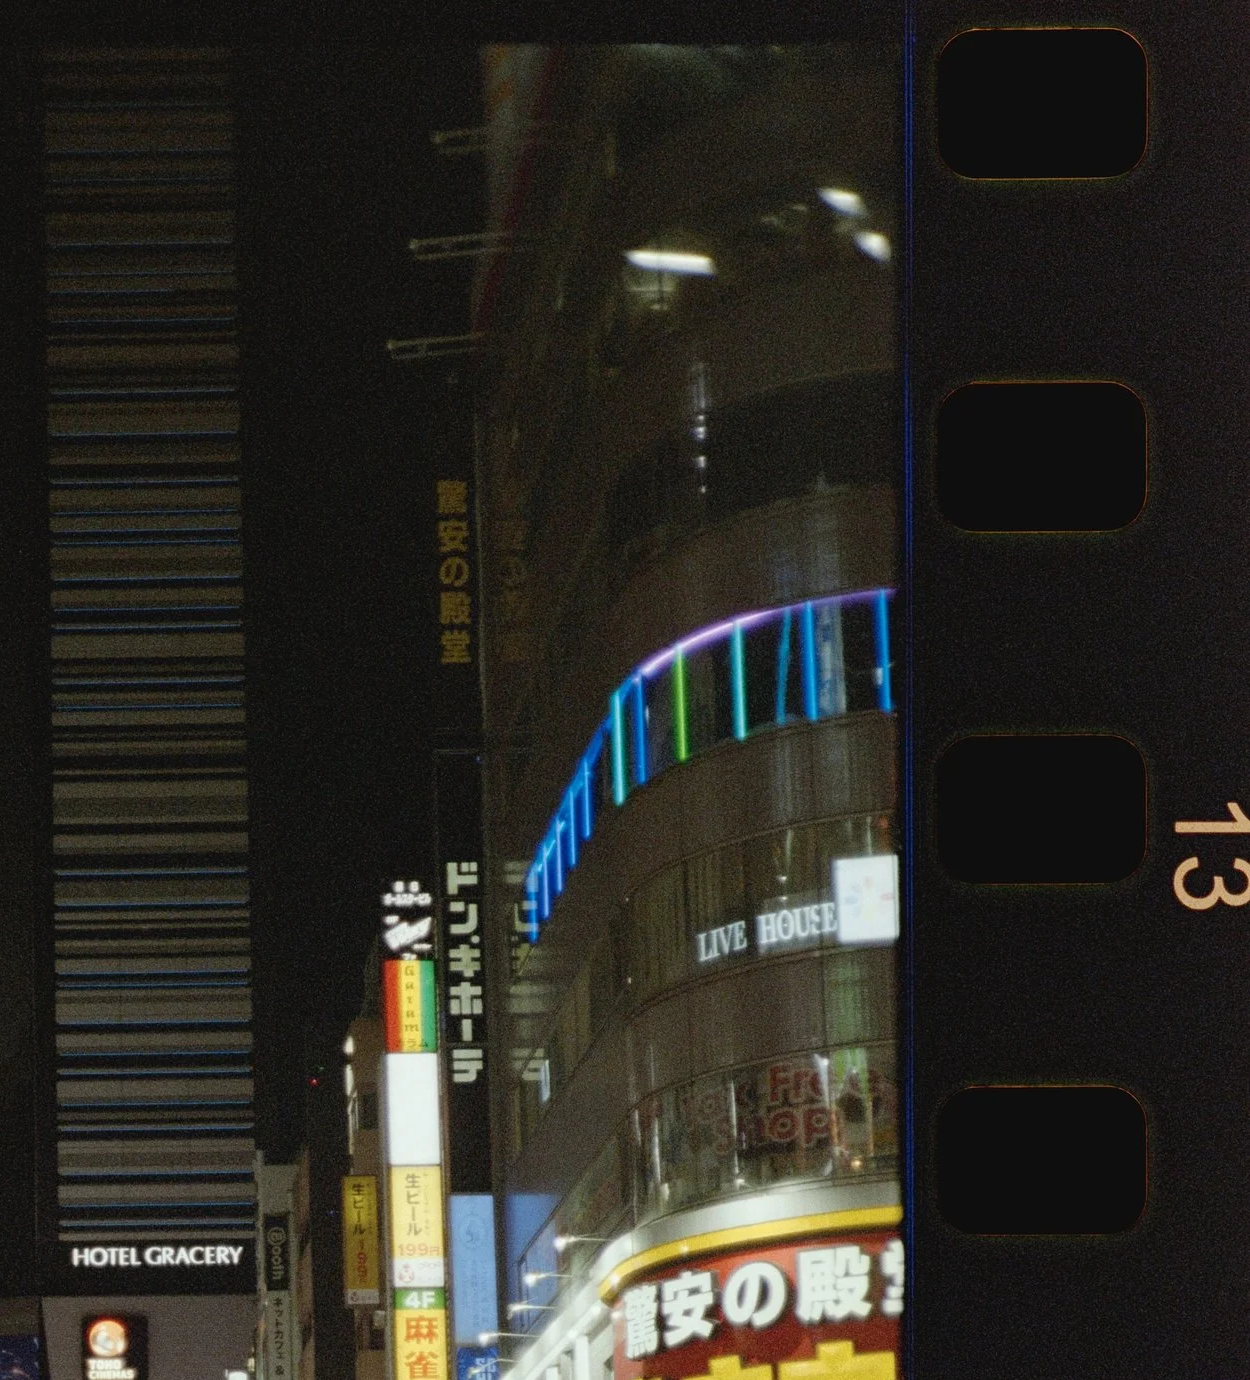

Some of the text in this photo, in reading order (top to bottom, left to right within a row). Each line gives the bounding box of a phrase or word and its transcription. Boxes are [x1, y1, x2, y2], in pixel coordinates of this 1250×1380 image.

[1174, 802, 1250, 910] 13
[698, 904, 838, 962] LIVE HOUSE
[404, 1172, 423, 1237] 生ビール
[71, 1245, 244, 1267] HOTEL GRACERY
[405, 1291, 436, 1309] 4F
[404, 1315, 440, 1380] 麻雀
